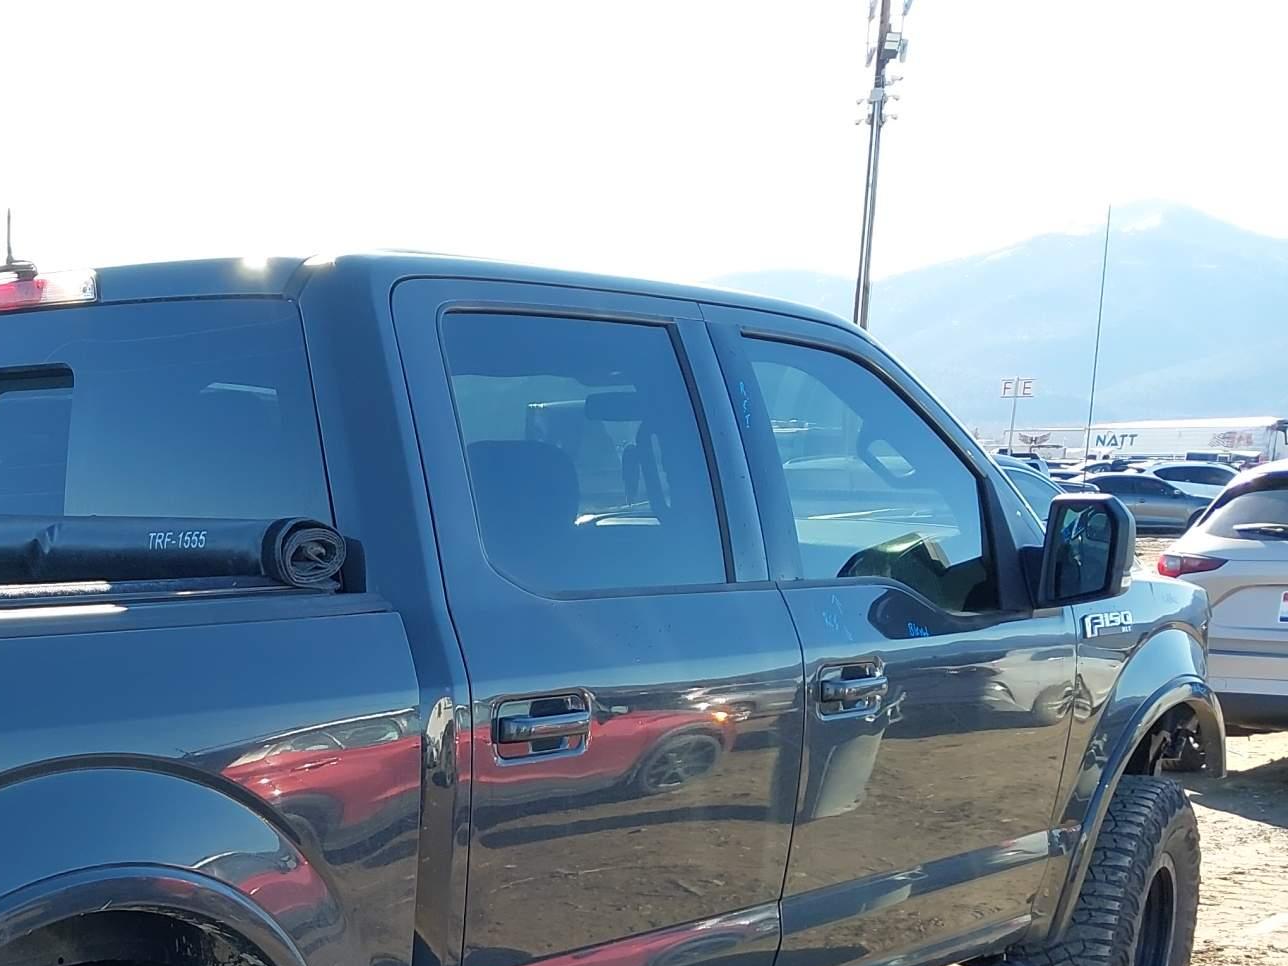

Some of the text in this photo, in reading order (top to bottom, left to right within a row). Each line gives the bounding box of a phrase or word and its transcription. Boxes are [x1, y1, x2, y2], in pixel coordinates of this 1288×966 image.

[1003, 381, 1033, 395] F E
[148, 530, 208, 550] TRF-1555
